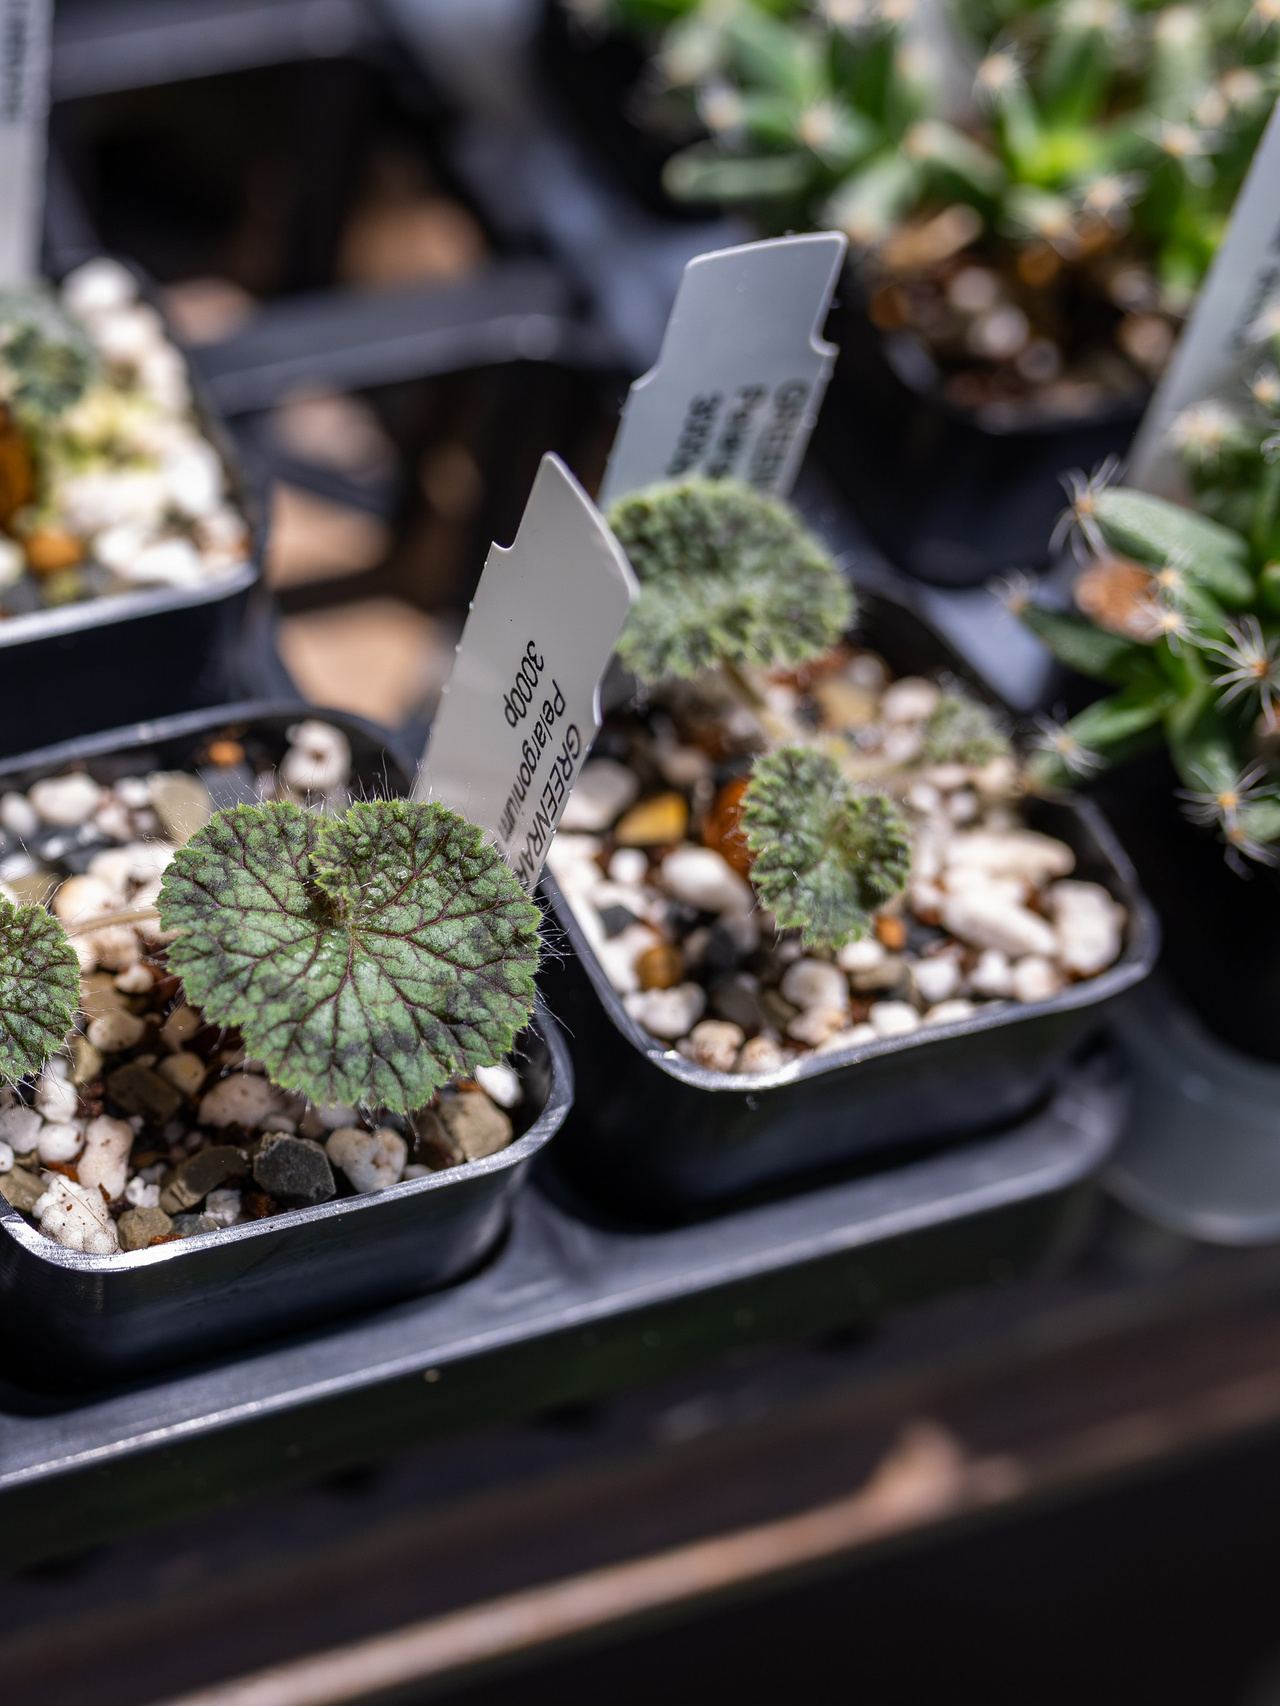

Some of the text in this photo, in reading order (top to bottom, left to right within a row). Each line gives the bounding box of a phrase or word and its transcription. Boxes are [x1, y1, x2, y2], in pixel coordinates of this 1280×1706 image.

[496, 679, 566, 843] Pelargonium
[503, 640, 545, 728] 3000p
[514, 724, 581, 892] GREENRAR
